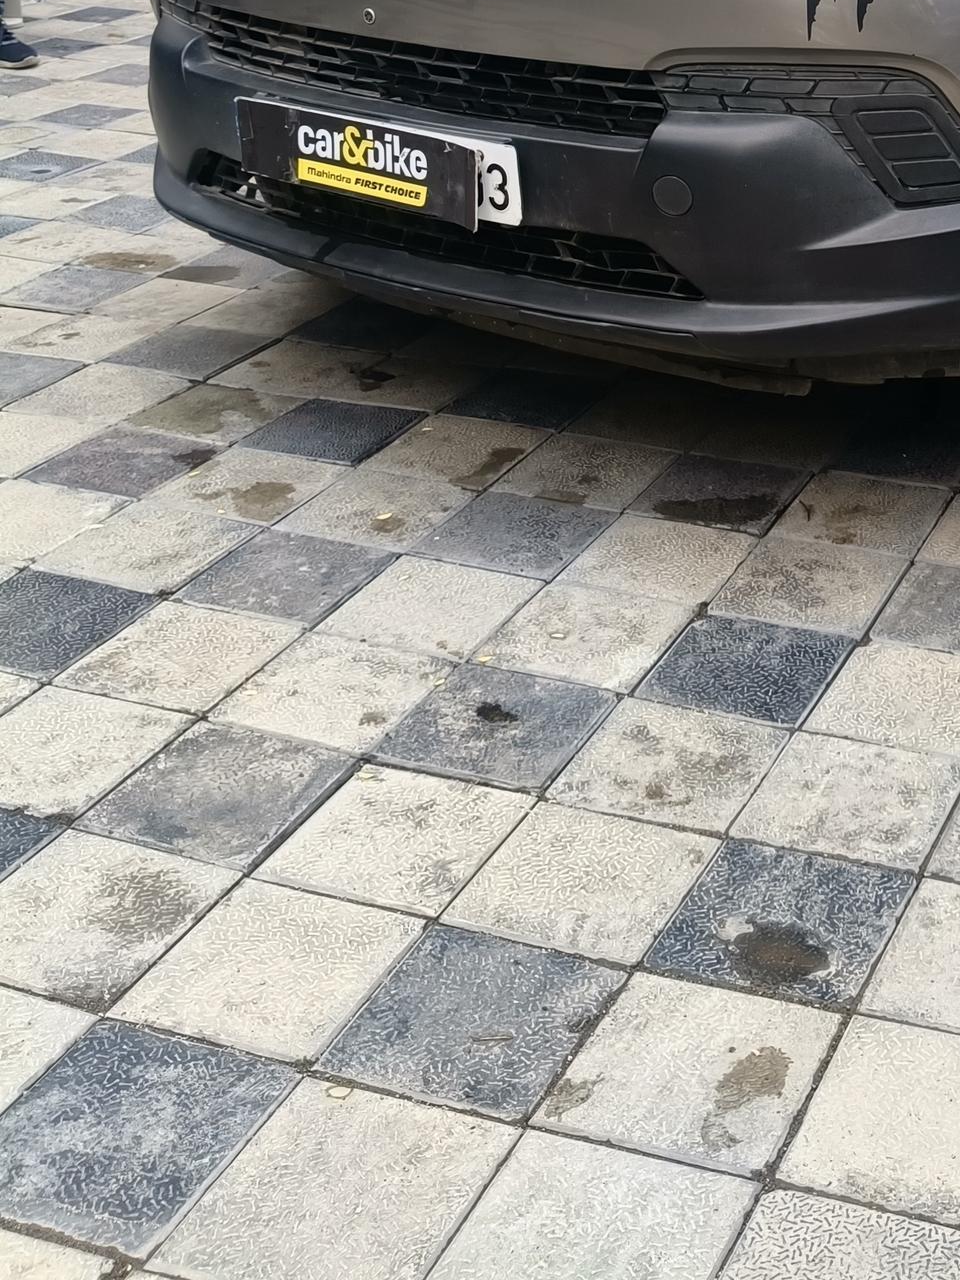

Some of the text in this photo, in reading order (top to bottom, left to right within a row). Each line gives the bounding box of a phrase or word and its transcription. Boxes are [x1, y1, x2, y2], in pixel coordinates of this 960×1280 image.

[297, 125, 428, 181] car&bike
[354, 177, 384, 191] FIRST
[384, 184, 422, 200] CHOICE
